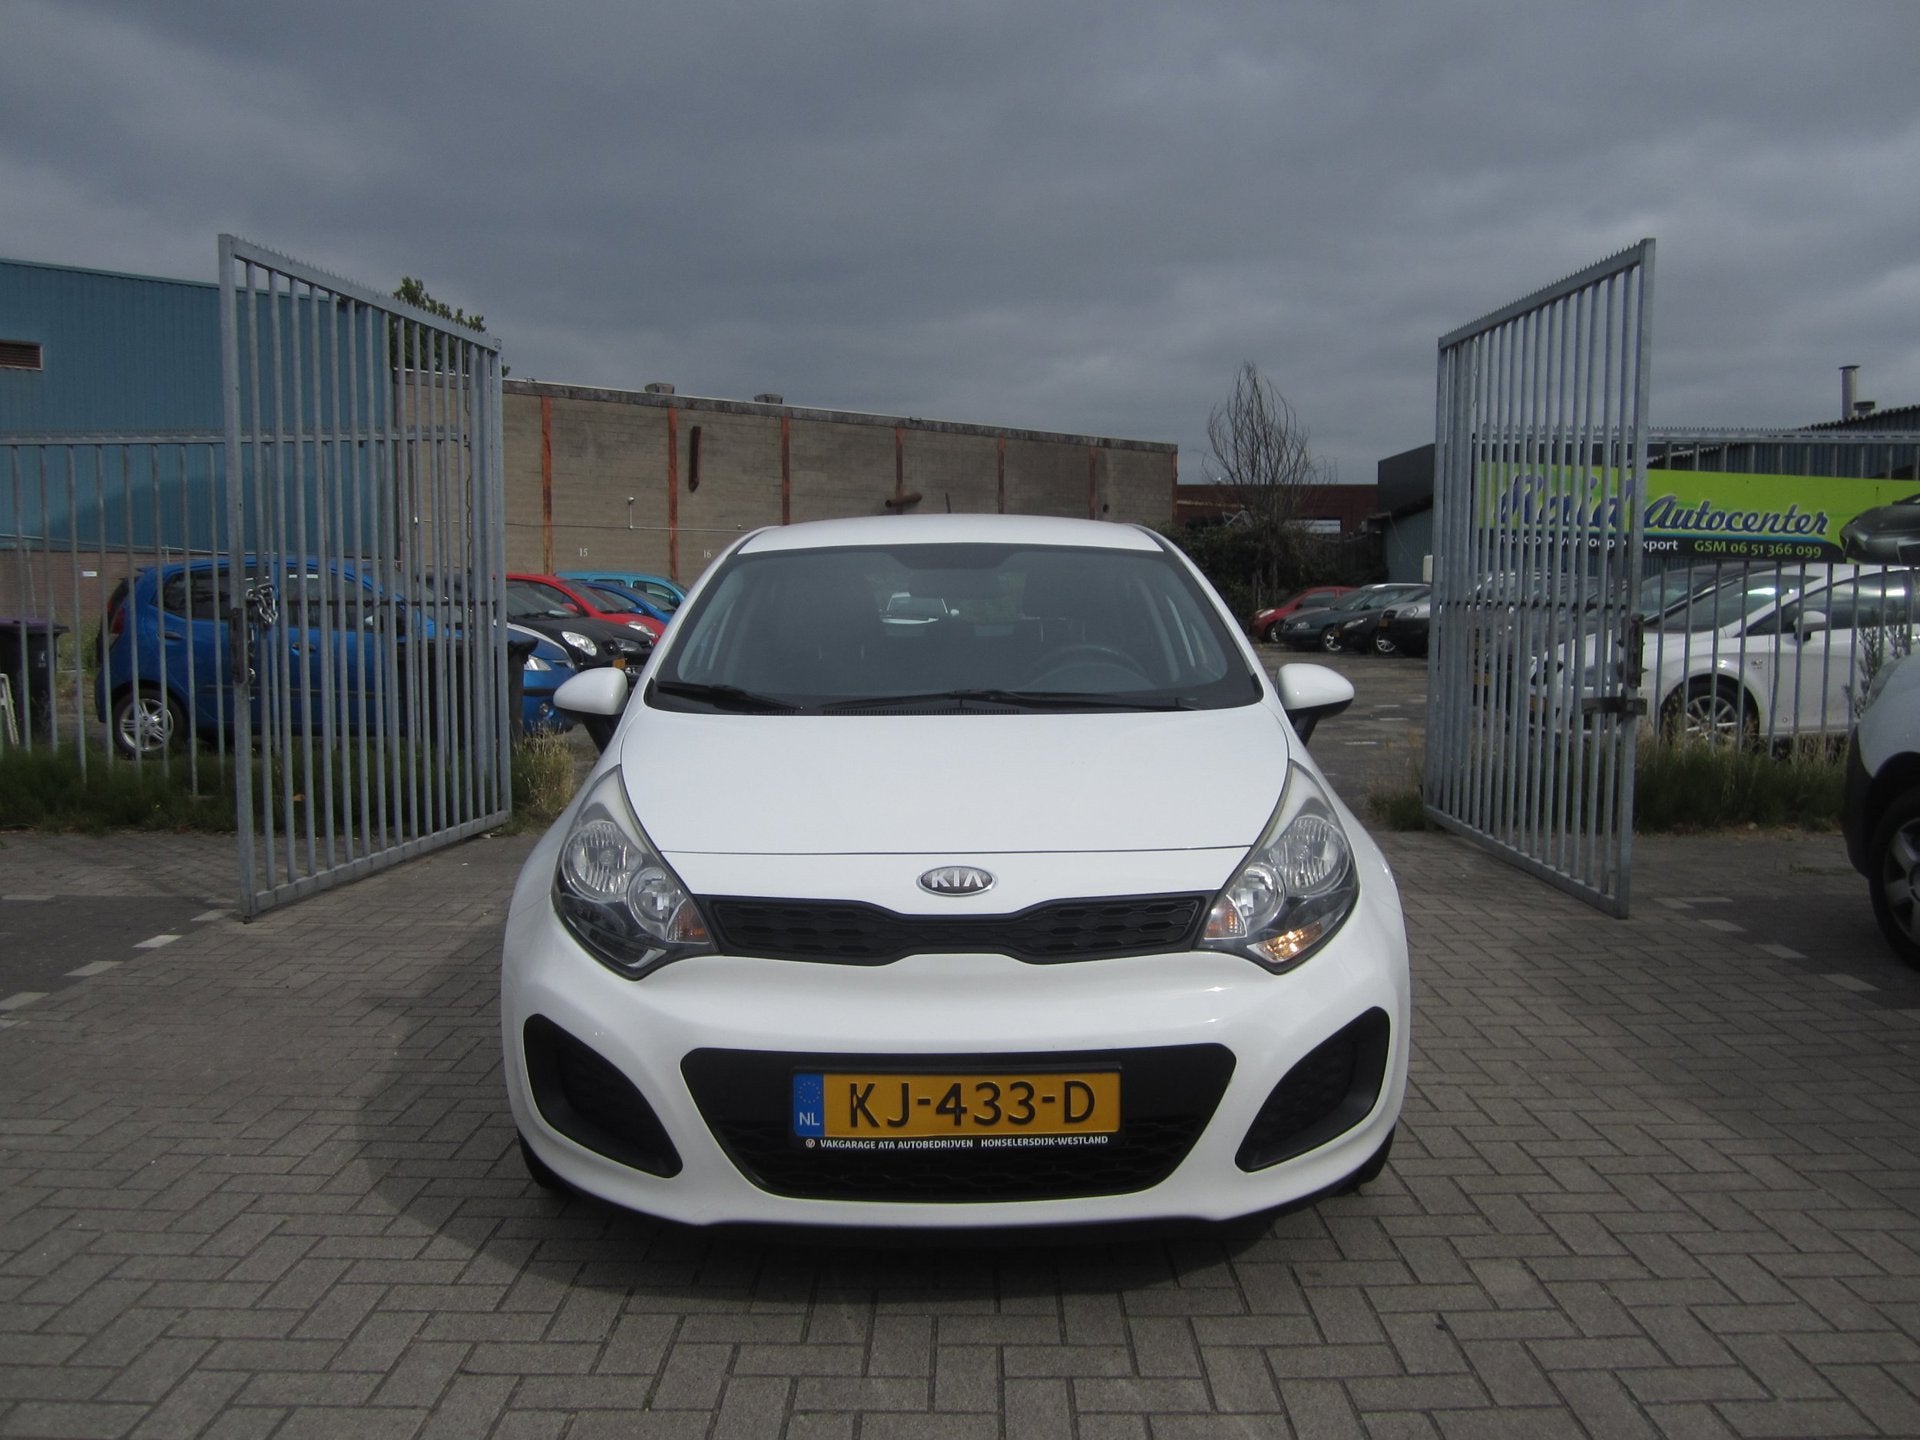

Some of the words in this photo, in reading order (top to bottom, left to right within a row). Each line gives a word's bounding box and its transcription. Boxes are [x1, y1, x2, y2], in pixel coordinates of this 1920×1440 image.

[1644, 494, 1828, 536] Autocenter
[579, 548, 588, 557] 15
[1642, 539, 1679, 552] xport
[1694, 540, 1726, 552] GSM
[1730, 544, 1748, 553] 06
[1750, 545, 1764, 556] 51
[1768, 545, 1793, 557] 366
[1796, 546, 1822, 559] 099
[703, 550, 712, 558] 16
[931, 869, 984, 888] KIA
[849, 1080, 1096, 1129] KJ-433-D
[799, 1112, 820, 1126] NL
[820, 1139, 876, 1149] VAKGARAGE
[878, 1140, 896, 1149] ATA
[898, 1139, 974, 1149] AUTOBEDRIJVEN
[981, 1135, 1109, 1148] HONSELERSDIJK-WESTLAND
